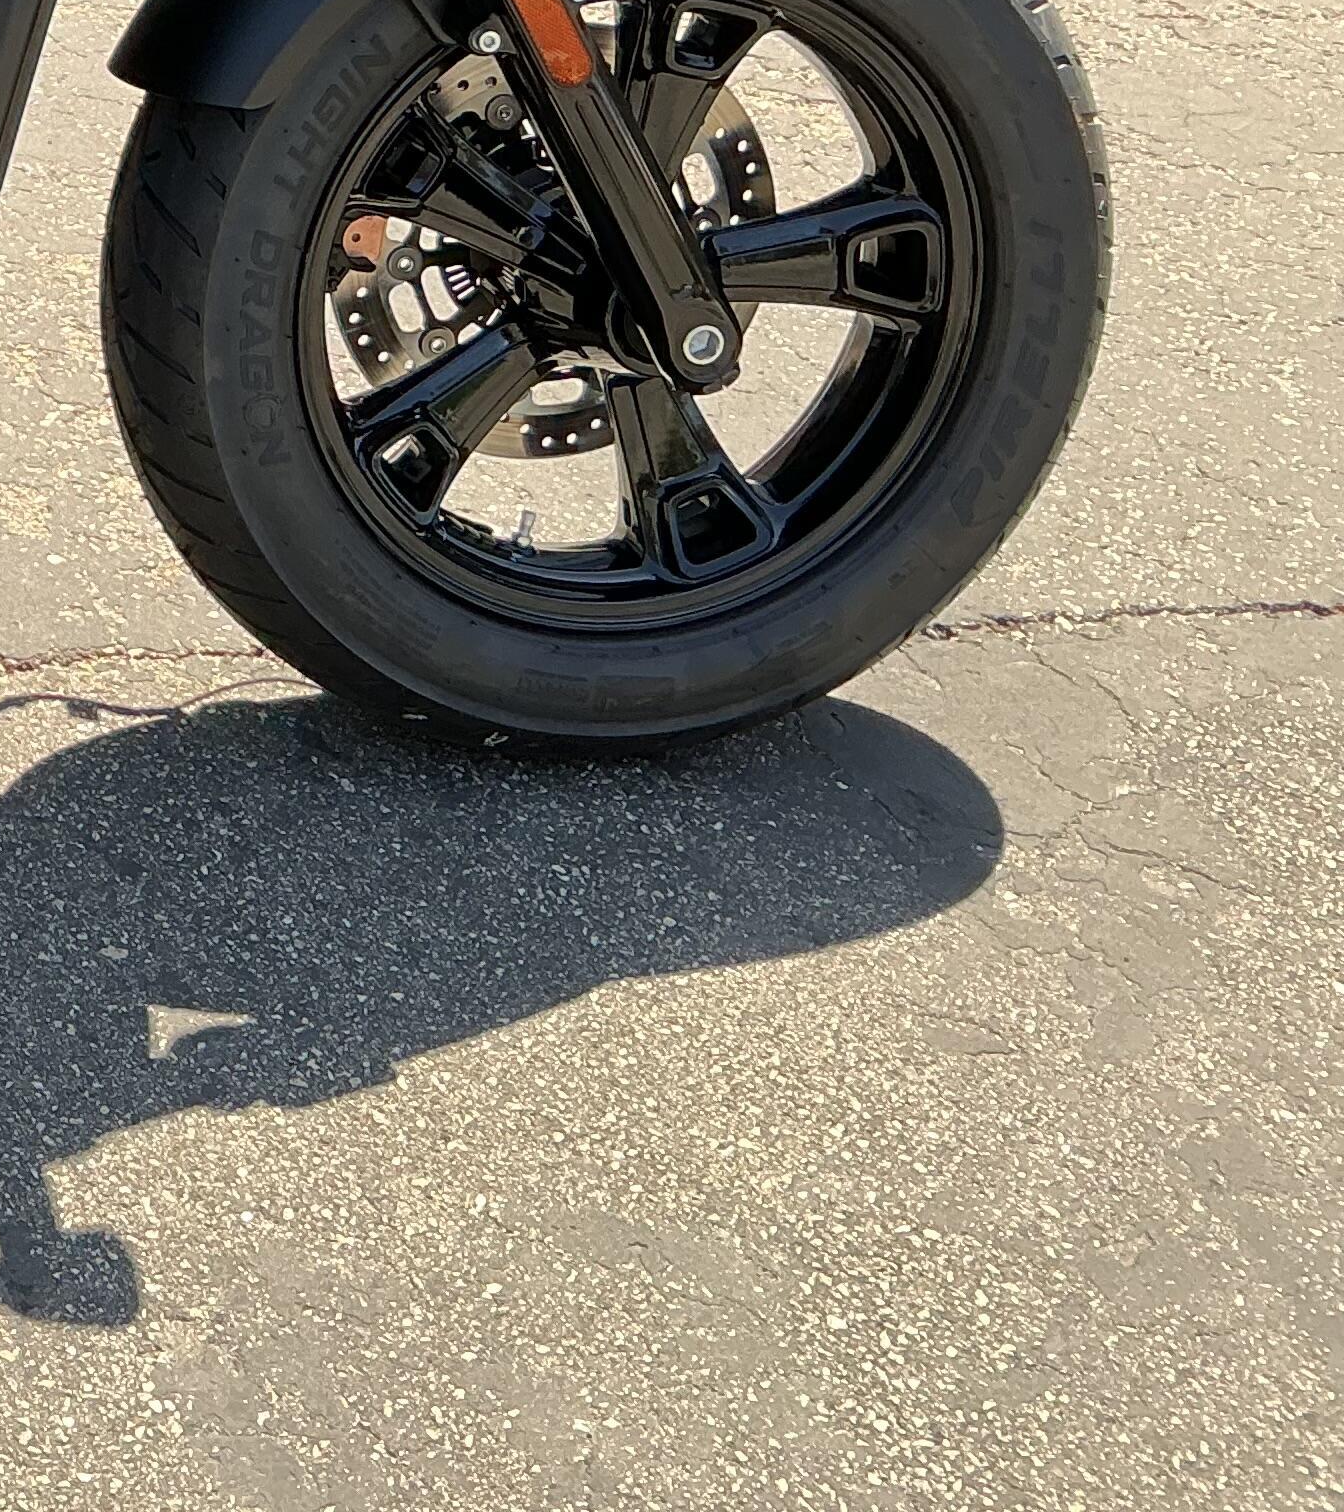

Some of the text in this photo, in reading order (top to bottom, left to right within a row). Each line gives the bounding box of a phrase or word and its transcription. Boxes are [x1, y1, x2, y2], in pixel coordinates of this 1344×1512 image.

[238, 31, 392, 468] NIGHT DRAGON
[950, 215, 1066, 530] PIRELLI
